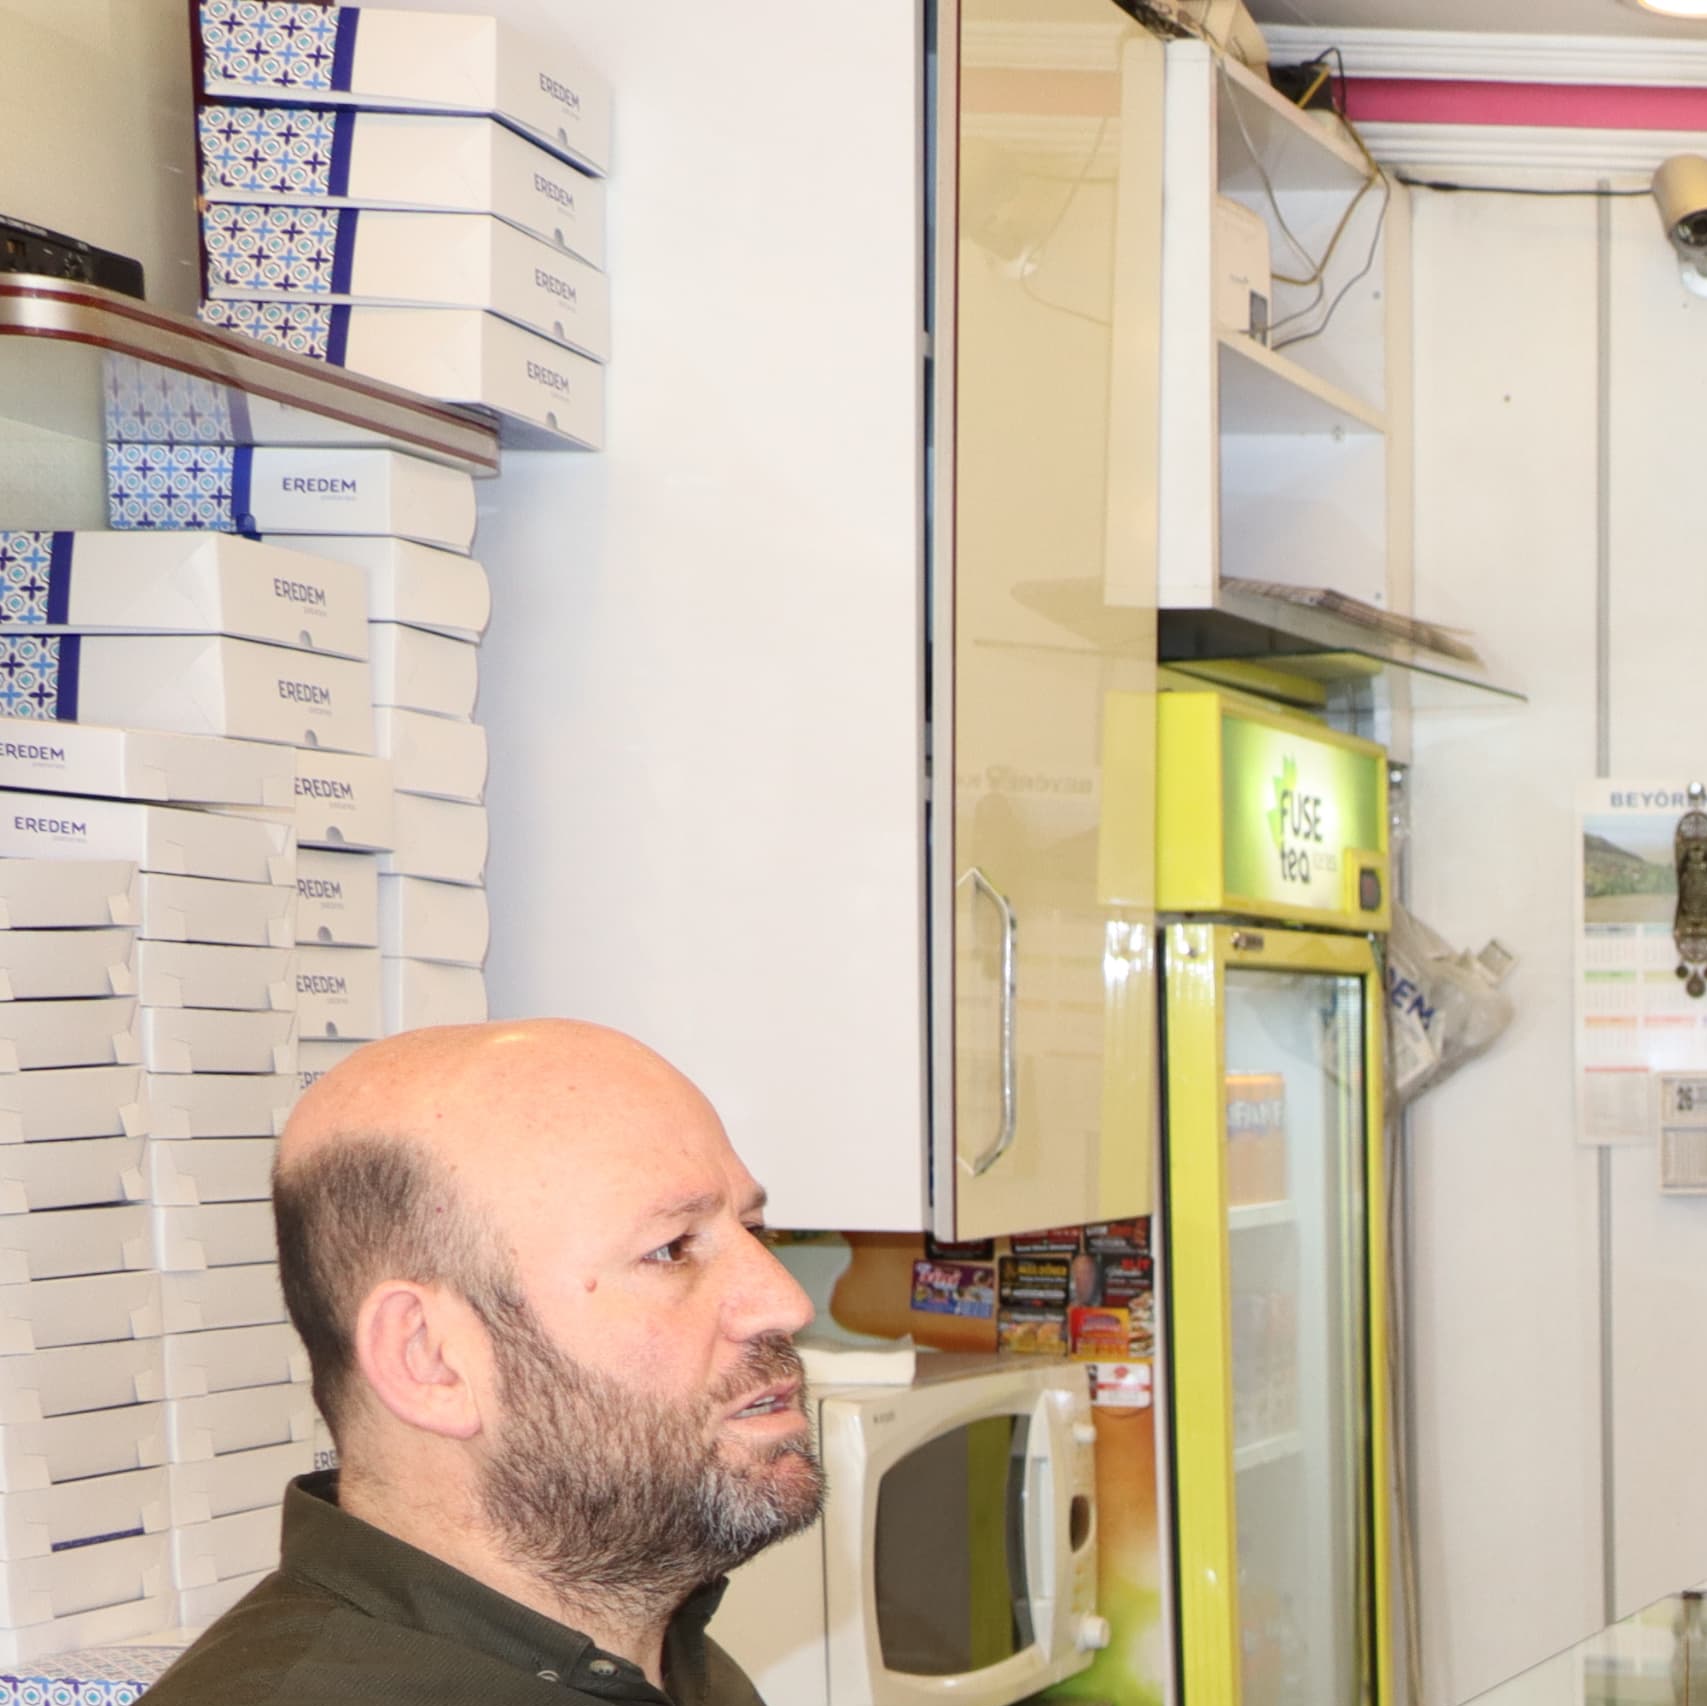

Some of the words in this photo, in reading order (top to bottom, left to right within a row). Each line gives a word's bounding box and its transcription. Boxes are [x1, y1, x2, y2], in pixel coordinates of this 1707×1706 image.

[538, 72, 580, 109] EREDEM
[533, 173, 575, 208] EREDEM
[534, 267, 577, 302] EREDEM
[526, 360, 570, 392] EREDEM
[282, 477, 357, 494] EREDEM
[273, 577, 326, 606] EREDEM
[277, 679, 331, 706] EREDEM
[14, 815, 87, 836] EREDEM
[1280, 789, 1324, 843] FUSE
[1280, 843, 1312, 885] tea
[297, 878, 343, 900] REDEM
